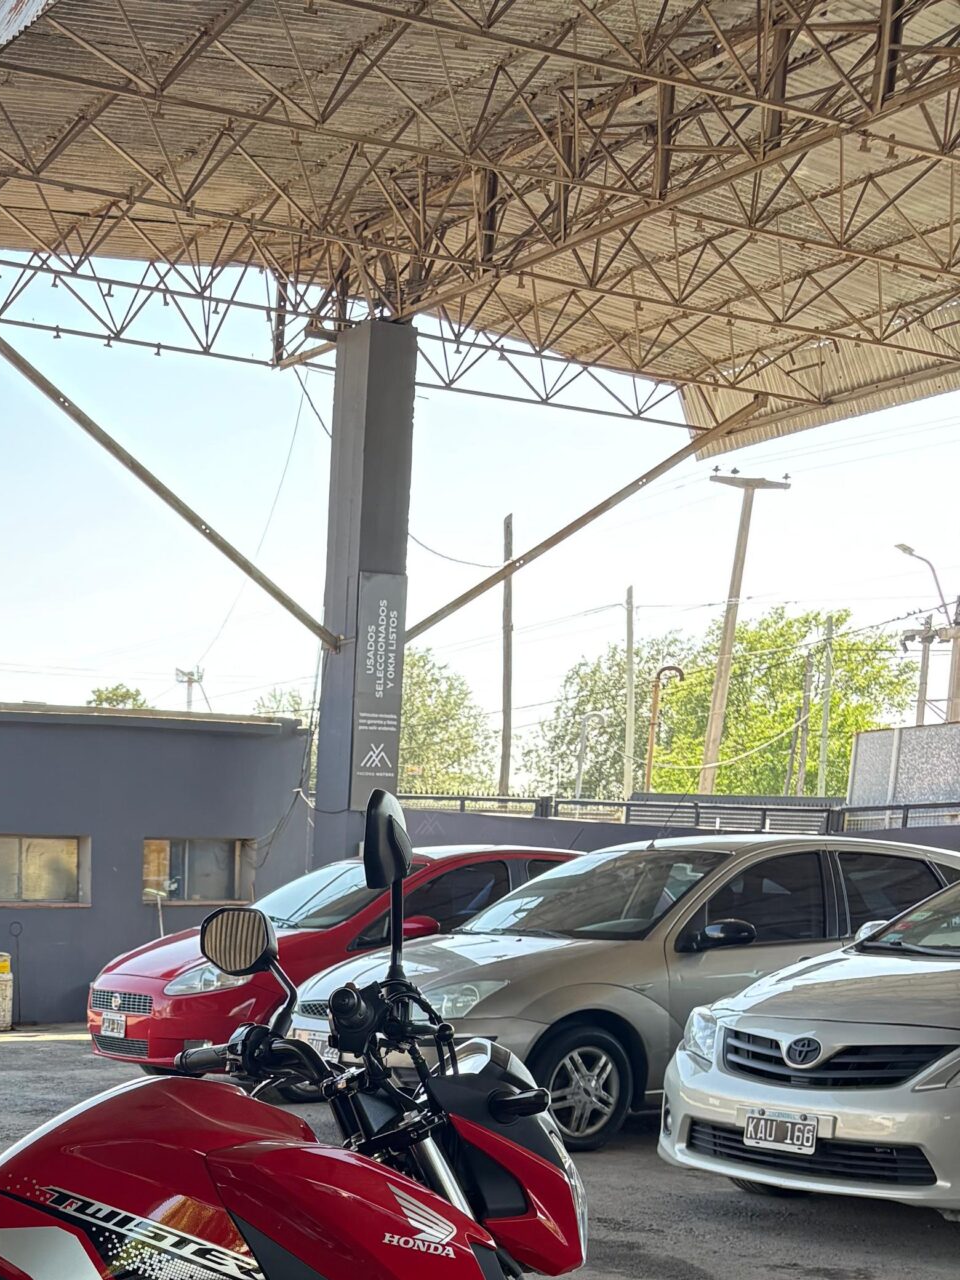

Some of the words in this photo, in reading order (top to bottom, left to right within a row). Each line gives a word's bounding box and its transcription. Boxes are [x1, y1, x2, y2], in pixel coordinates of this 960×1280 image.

[366, 625, 376, 674] USADOS
[375, 599, 388, 698] SELECCIONADOS
[388, 610, 398, 651] LISTOS
[747, 1118, 776, 1140] KAU
[382, 1232, 457, 1259] HONDA
